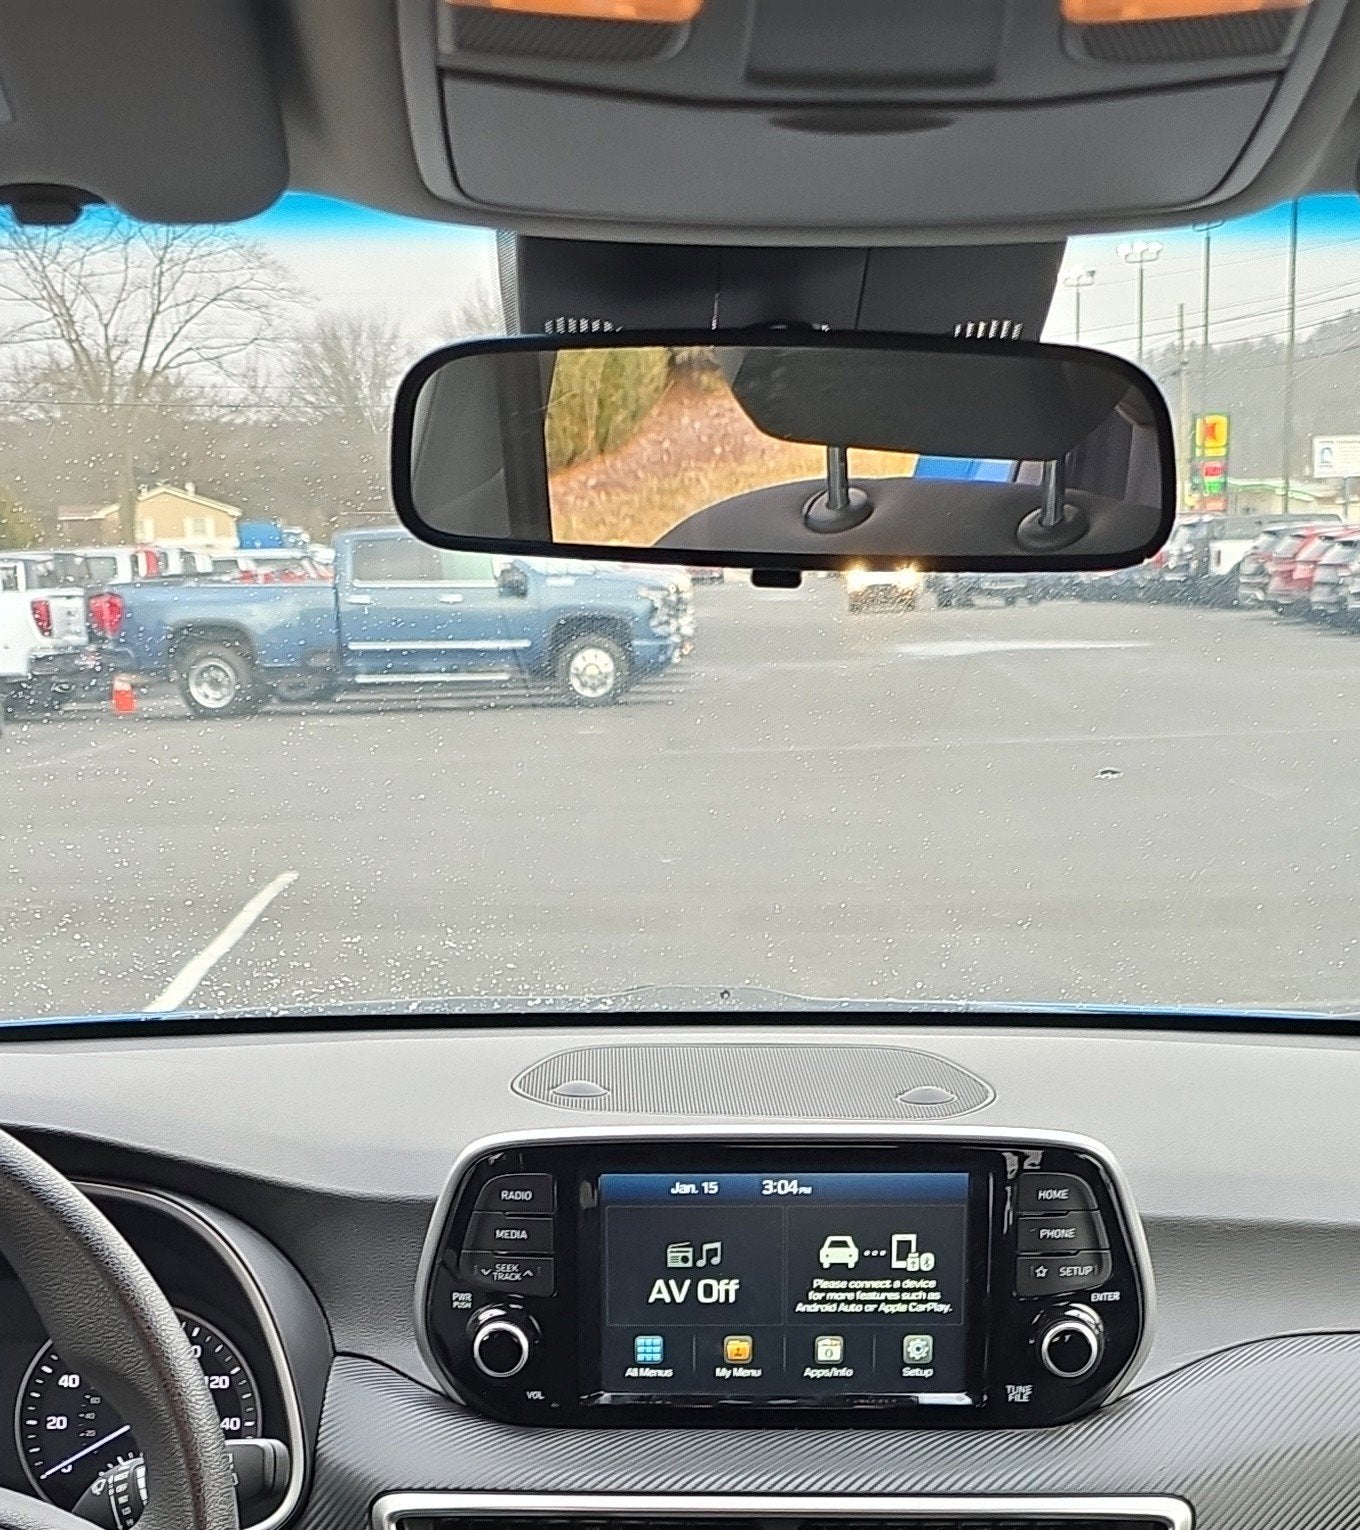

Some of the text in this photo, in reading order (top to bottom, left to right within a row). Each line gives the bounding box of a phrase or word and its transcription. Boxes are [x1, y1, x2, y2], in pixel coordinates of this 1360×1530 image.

[670, 1182, 719, 1194] Jan. 15
[761, 1180, 798, 1195] 3:04
[501, 1190, 532, 1201] RADIO
[1038, 1189, 1069, 1200] HOME
[495, 1230, 528, 1239] MEDIA
[1040, 1228, 1076, 1239] PHONE
[495, 1264, 519, 1272] SEEK
[1059, 1266, 1093, 1276] SETUP
[493, 1272, 522, 1281] TRACK
[813, 1279, 937, 1289] Please connect a device
[648, 1278, 740, 1304] AV Off
[808, 1290, 941, 1300] for more features such as
[452, 1292, 472, 1302] PWR
[1091, 1292, 1120, 1302] ENTER
[795, 1302, 953, 1315] Android Auto or Apple CarPlay.
[625, 1367, 673, 1378] All Menus
[715, 1367, 762, 1380] My Menu
[902, 1367, 934, 1379] Setup
[58, 1375, 80, 1388] 40
[526, 1390, 545, 1400] VOL
[1006, 1385, 1033, 1394] TUNE
[1008, 1393, 1030, 1402] FILE
[46, 1416, 68, 1430] 20
